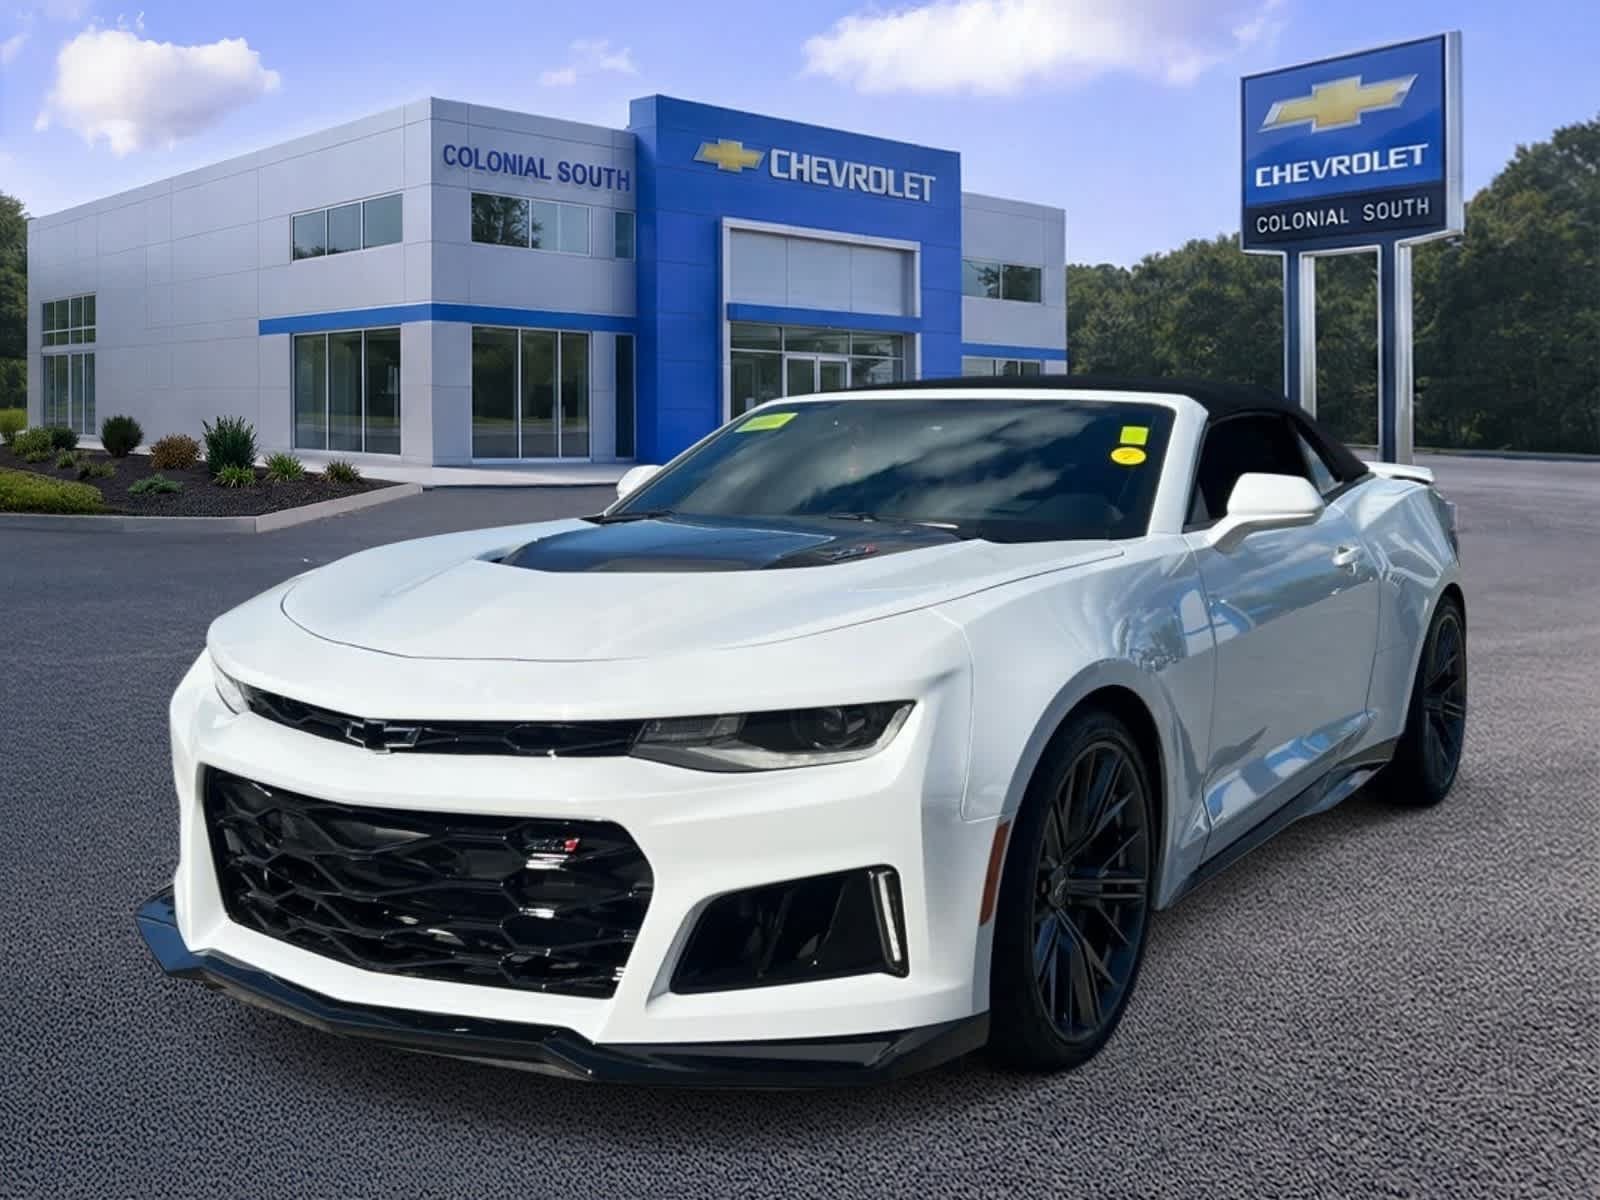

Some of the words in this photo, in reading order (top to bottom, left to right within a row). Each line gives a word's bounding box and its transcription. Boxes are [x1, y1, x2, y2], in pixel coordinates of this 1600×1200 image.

[443, 144, 552, 181] COLONIAL
[557, 161, 631, 192] SOUTH
[769, 148, 937, 203] CHEVROLET
[1255, 143, 1429, 188] CHEVROLET
[1256, 207, 1350, 234] COLONIAL
[1363, 197, 1430, 222] SOUTH
